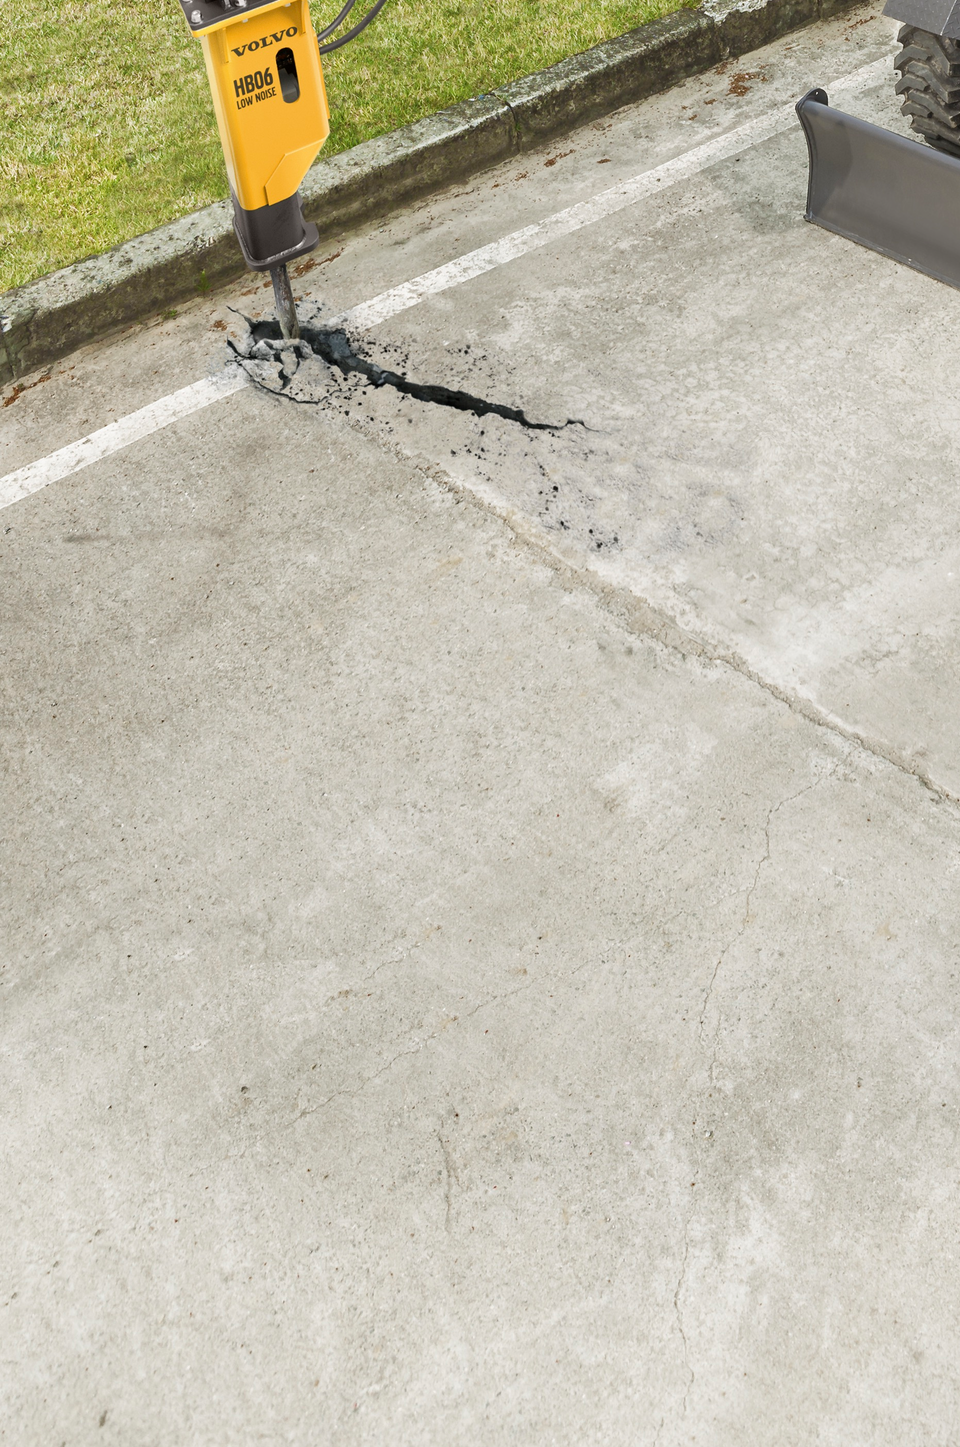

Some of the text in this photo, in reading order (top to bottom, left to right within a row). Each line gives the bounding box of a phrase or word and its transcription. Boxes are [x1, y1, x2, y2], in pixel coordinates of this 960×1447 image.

[231, 26, 298, 58] VOLVO
[233, 67, 274, 98] HB06
[236, 86, 277, 110] LOW NOISE
